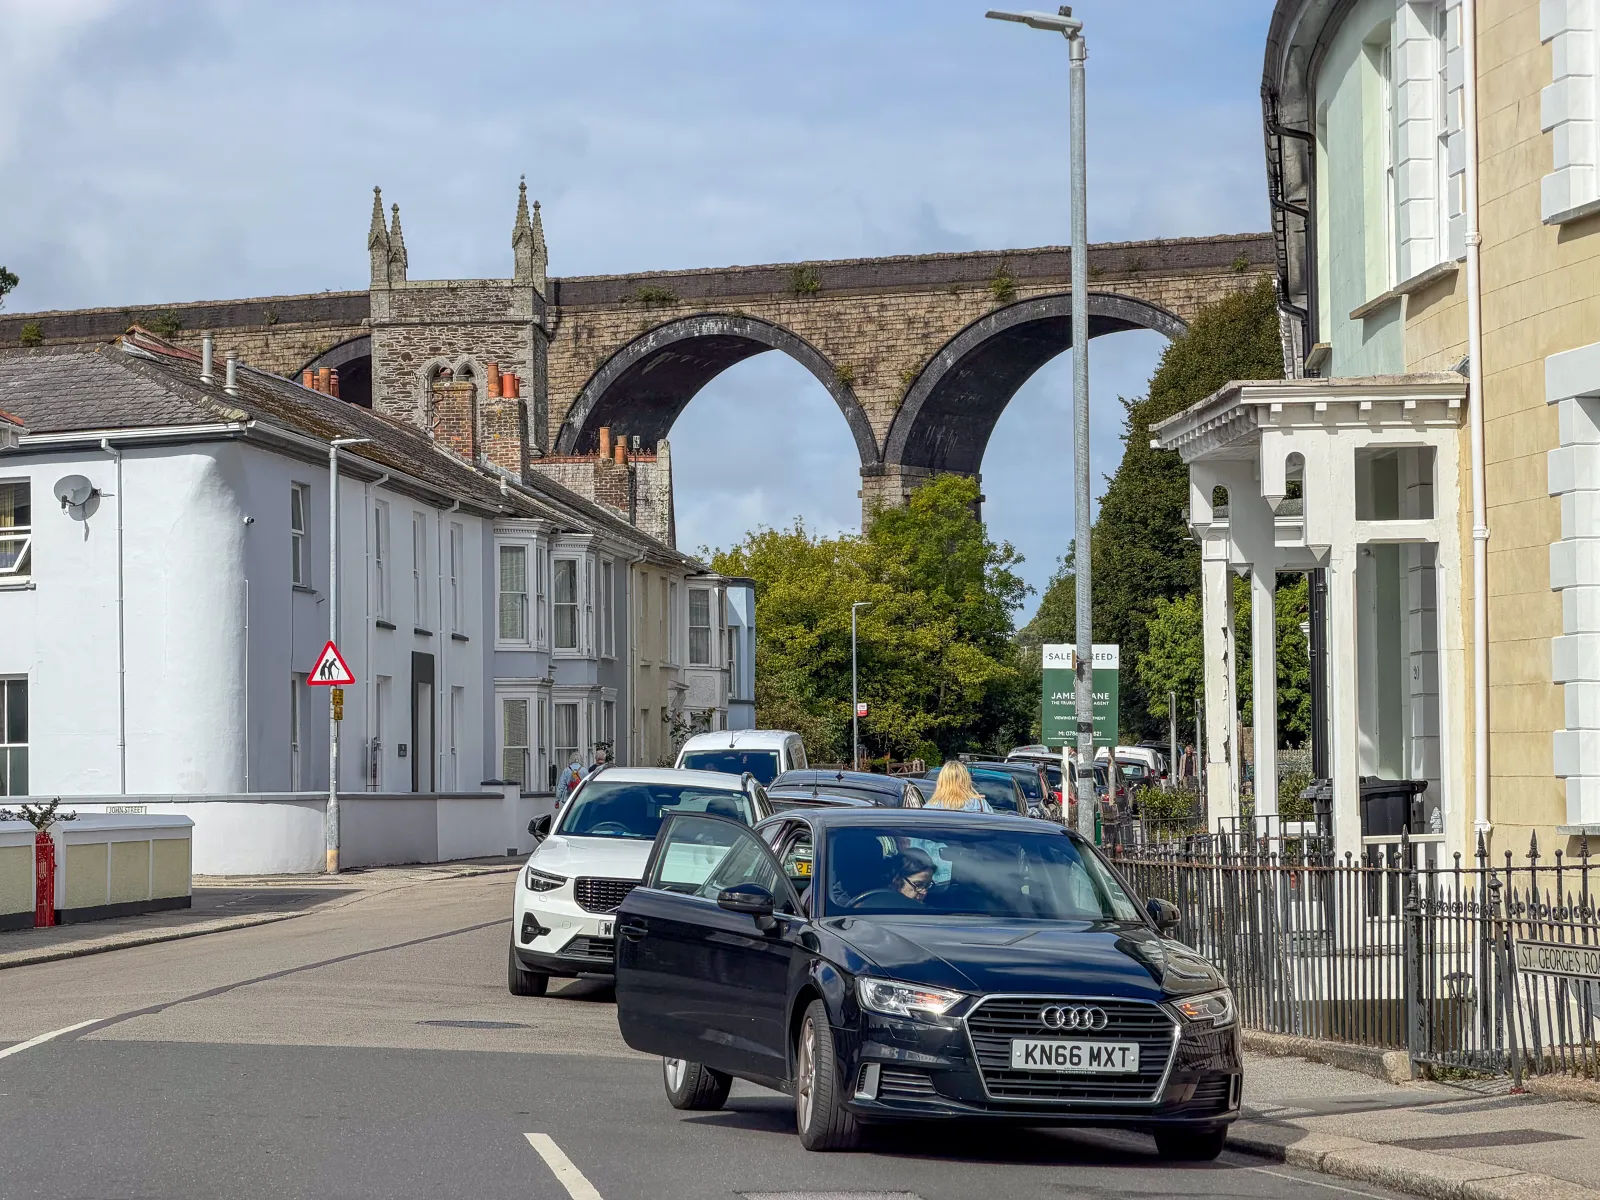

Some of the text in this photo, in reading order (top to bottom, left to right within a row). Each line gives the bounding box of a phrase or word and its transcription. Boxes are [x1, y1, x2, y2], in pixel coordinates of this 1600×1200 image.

[1048, 652, 1071, 661] SALE
[1051, 692, 1110, 700] JAME ANE
[1522, 946, 1536, 968] ST.
[1538, 948, 1580, 972] GEORGE'S
[1024, 1043, 1131, 1068] KN66 MXT
